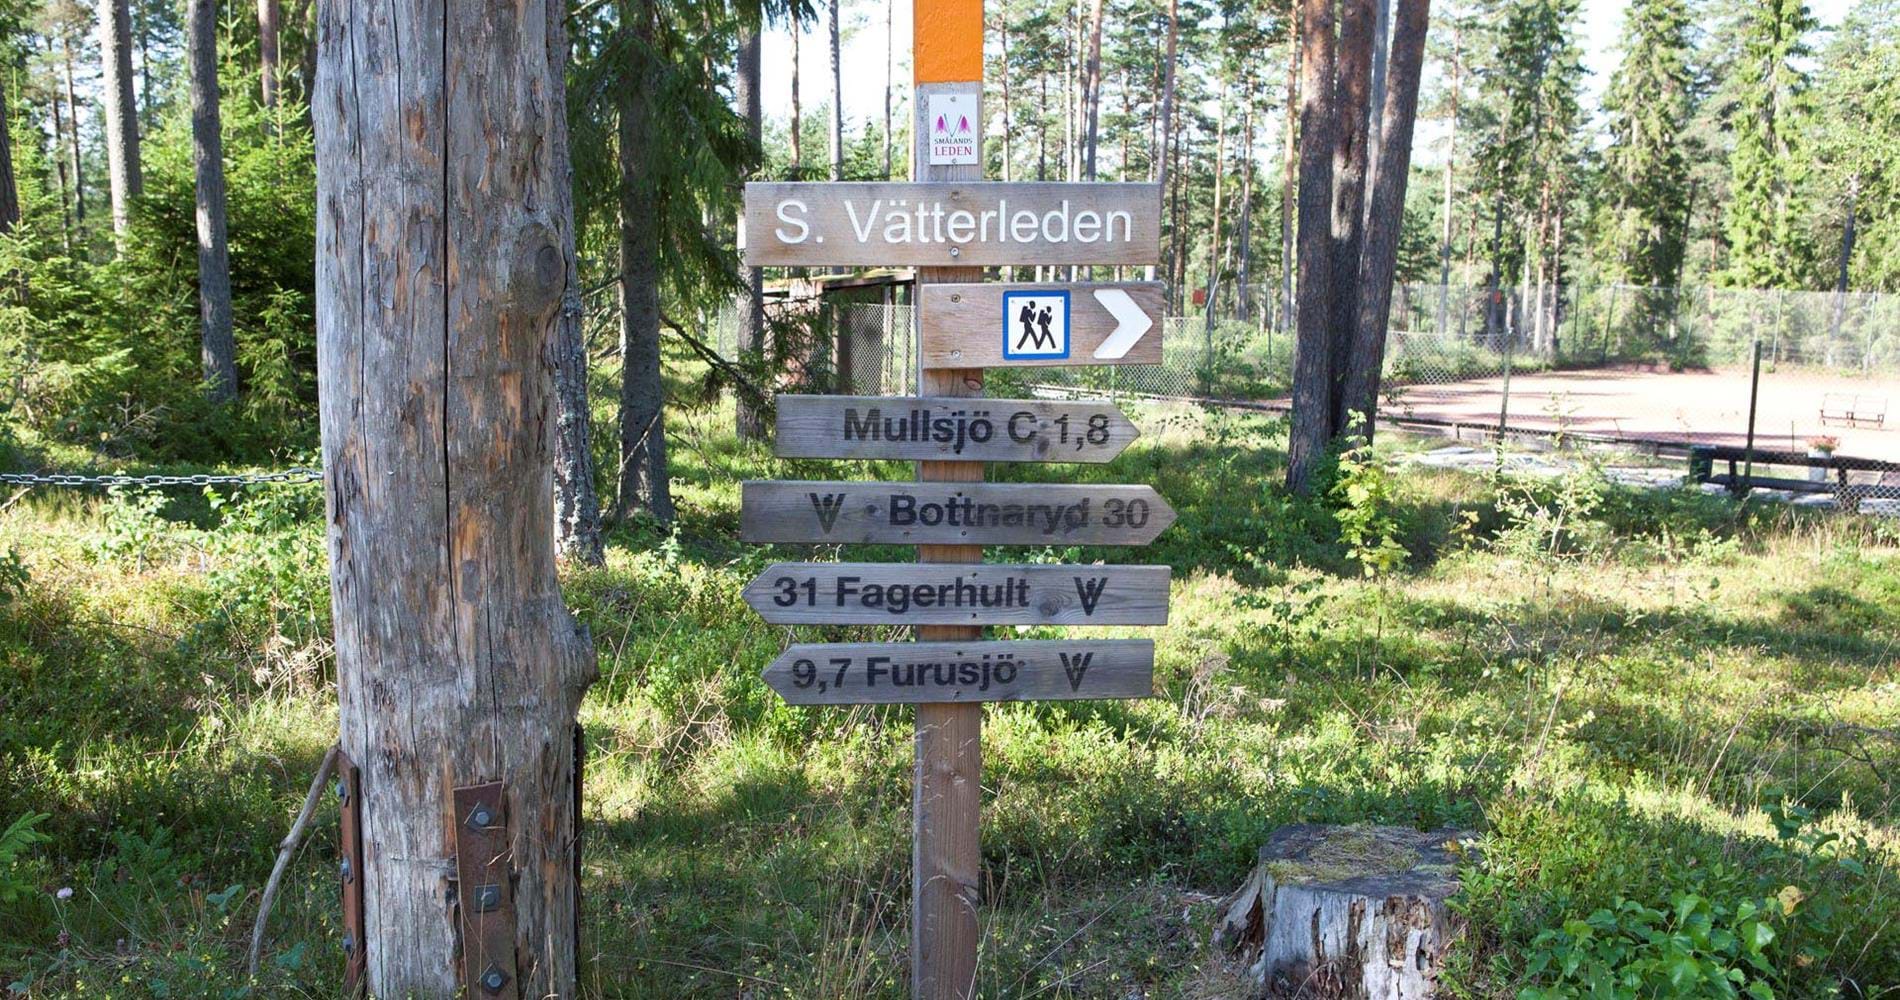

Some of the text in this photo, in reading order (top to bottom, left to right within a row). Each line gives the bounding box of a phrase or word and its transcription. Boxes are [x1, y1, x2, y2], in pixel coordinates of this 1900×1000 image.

[934, 136, 973, 145] SMÅLANDS
[935, 146, 972, 156] LEDEN
[775, 199, 1133, 244] S. Vätterleden
[844, 408, 1110, 451] Mullsjö C 1,8
[889, 494, 1150, 535] Bottnaryd 30
[773, 576, 1030, 614] 31 Fagerhult
[792, 654, 1018, 694] 9,7 Furusjö
